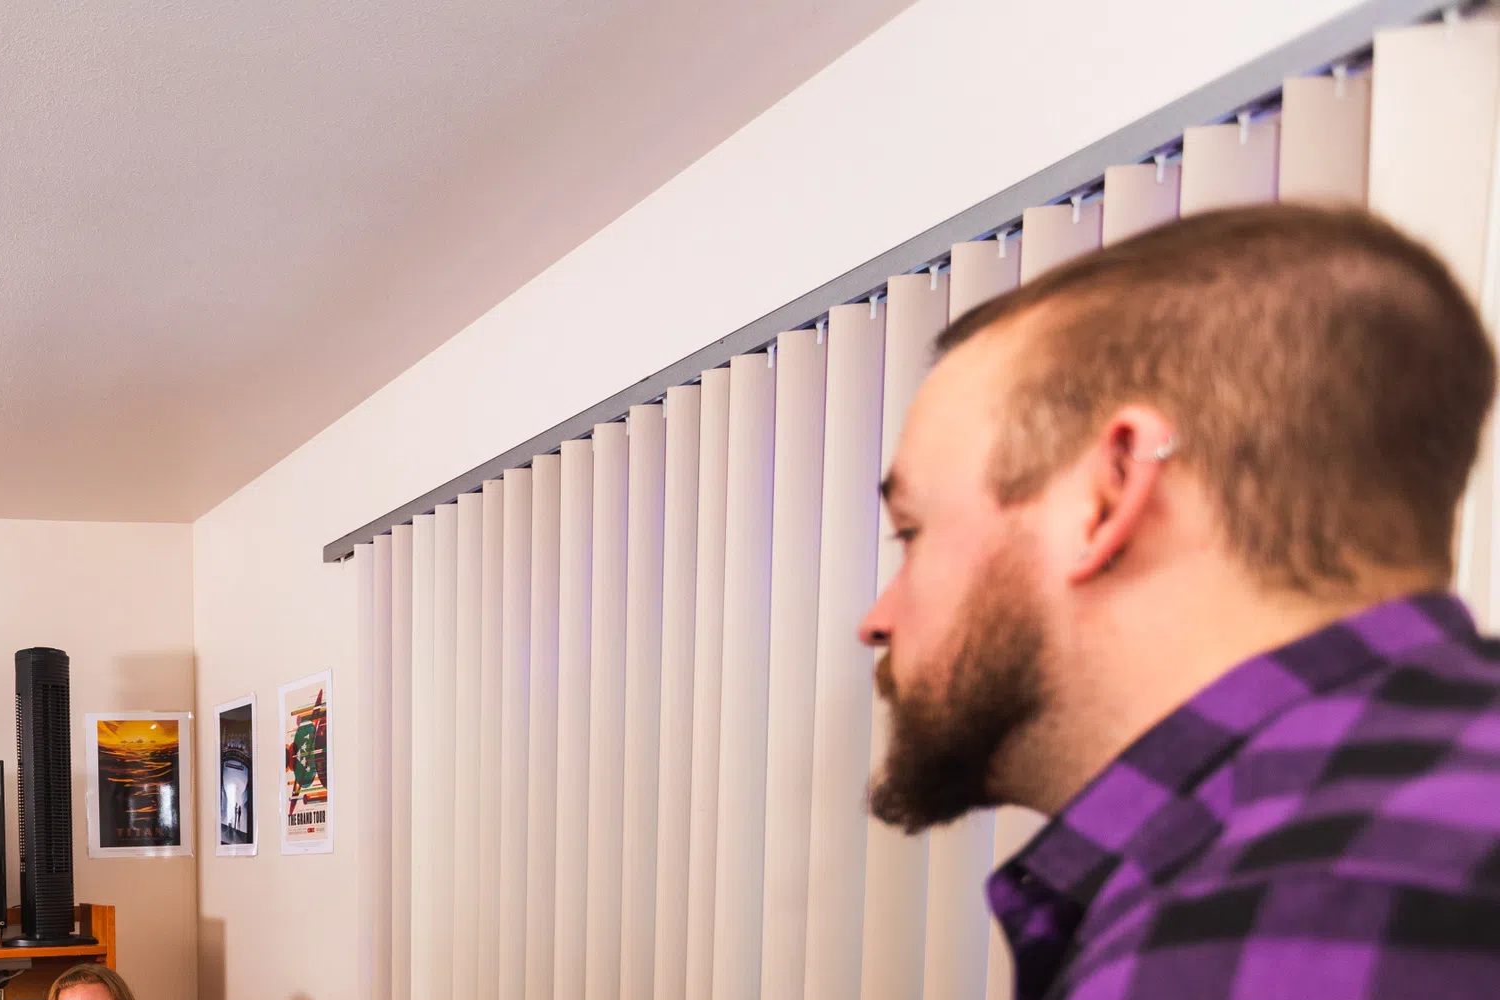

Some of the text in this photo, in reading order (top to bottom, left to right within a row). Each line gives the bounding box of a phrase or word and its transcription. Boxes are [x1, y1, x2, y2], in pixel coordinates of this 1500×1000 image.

[288, 810, 326, 827] THE GRAND TOUR
